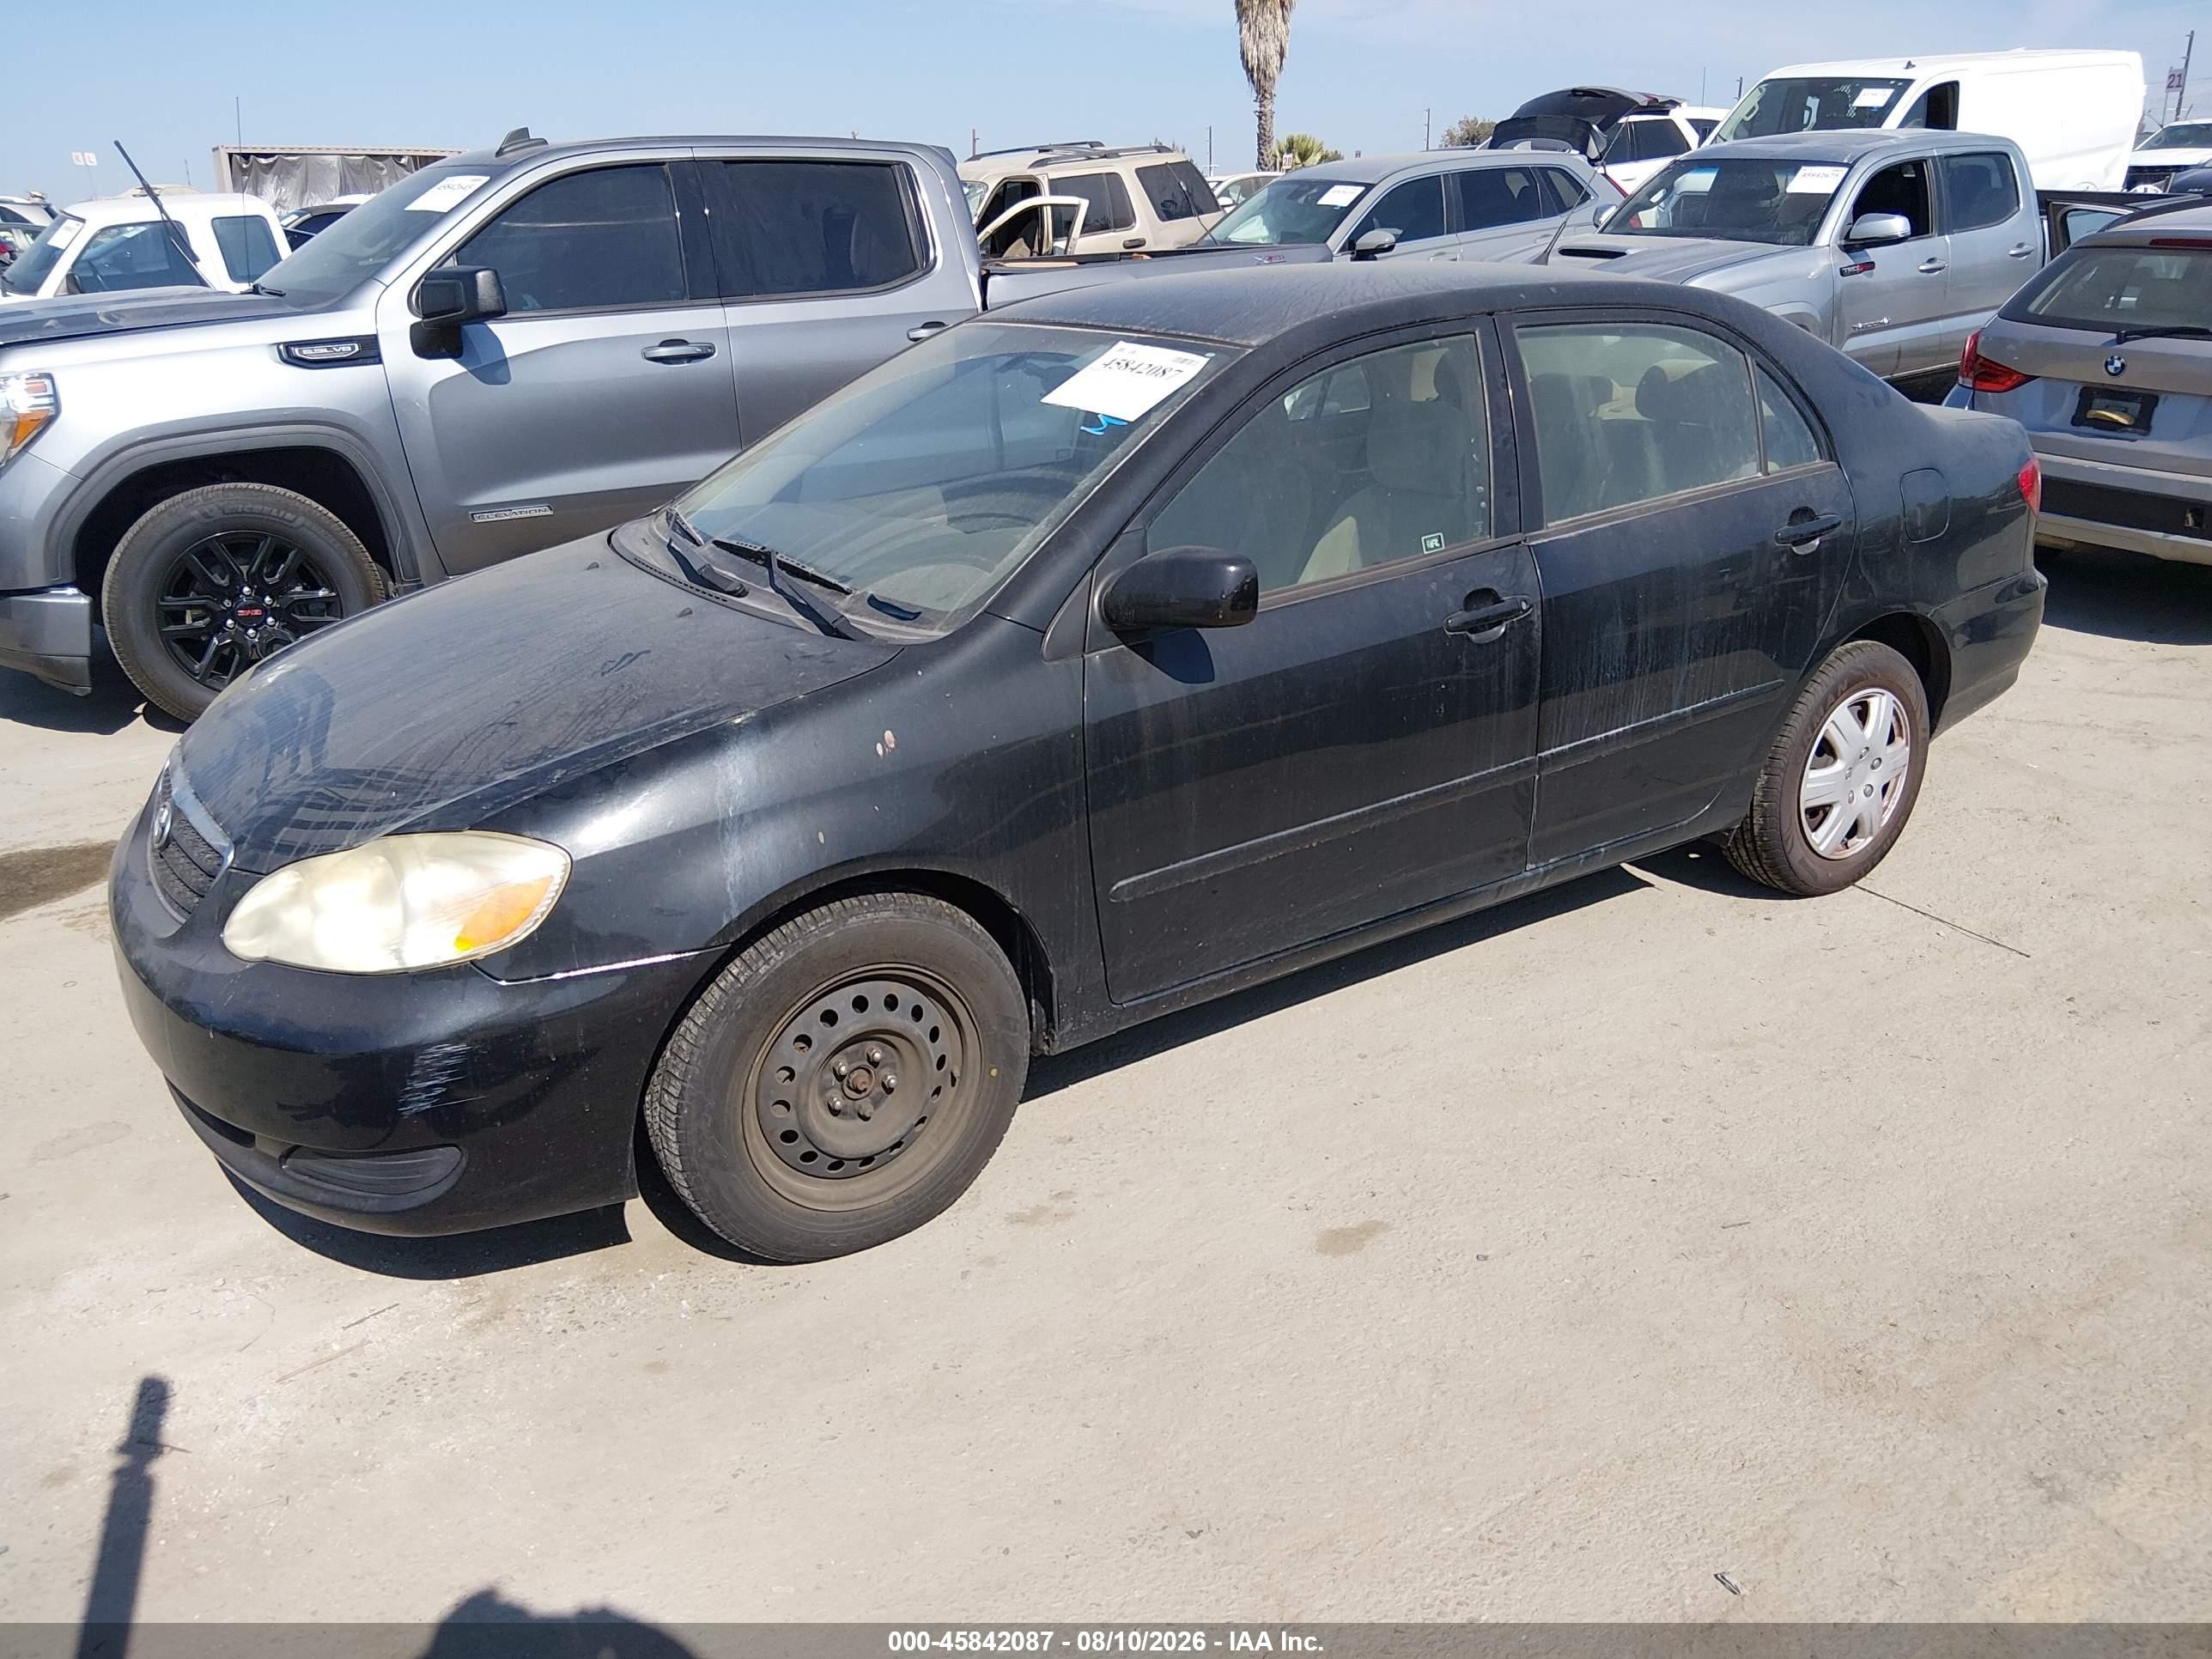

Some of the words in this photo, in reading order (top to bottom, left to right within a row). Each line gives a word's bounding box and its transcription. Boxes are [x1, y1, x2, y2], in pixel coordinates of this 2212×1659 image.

[2166, 74, 2182, 88] 21
[1283, 157, 1292, 167] 28
[1102, 357, 1184, 380] 45842087
[476, 507, 550, 520] ELEVATION
